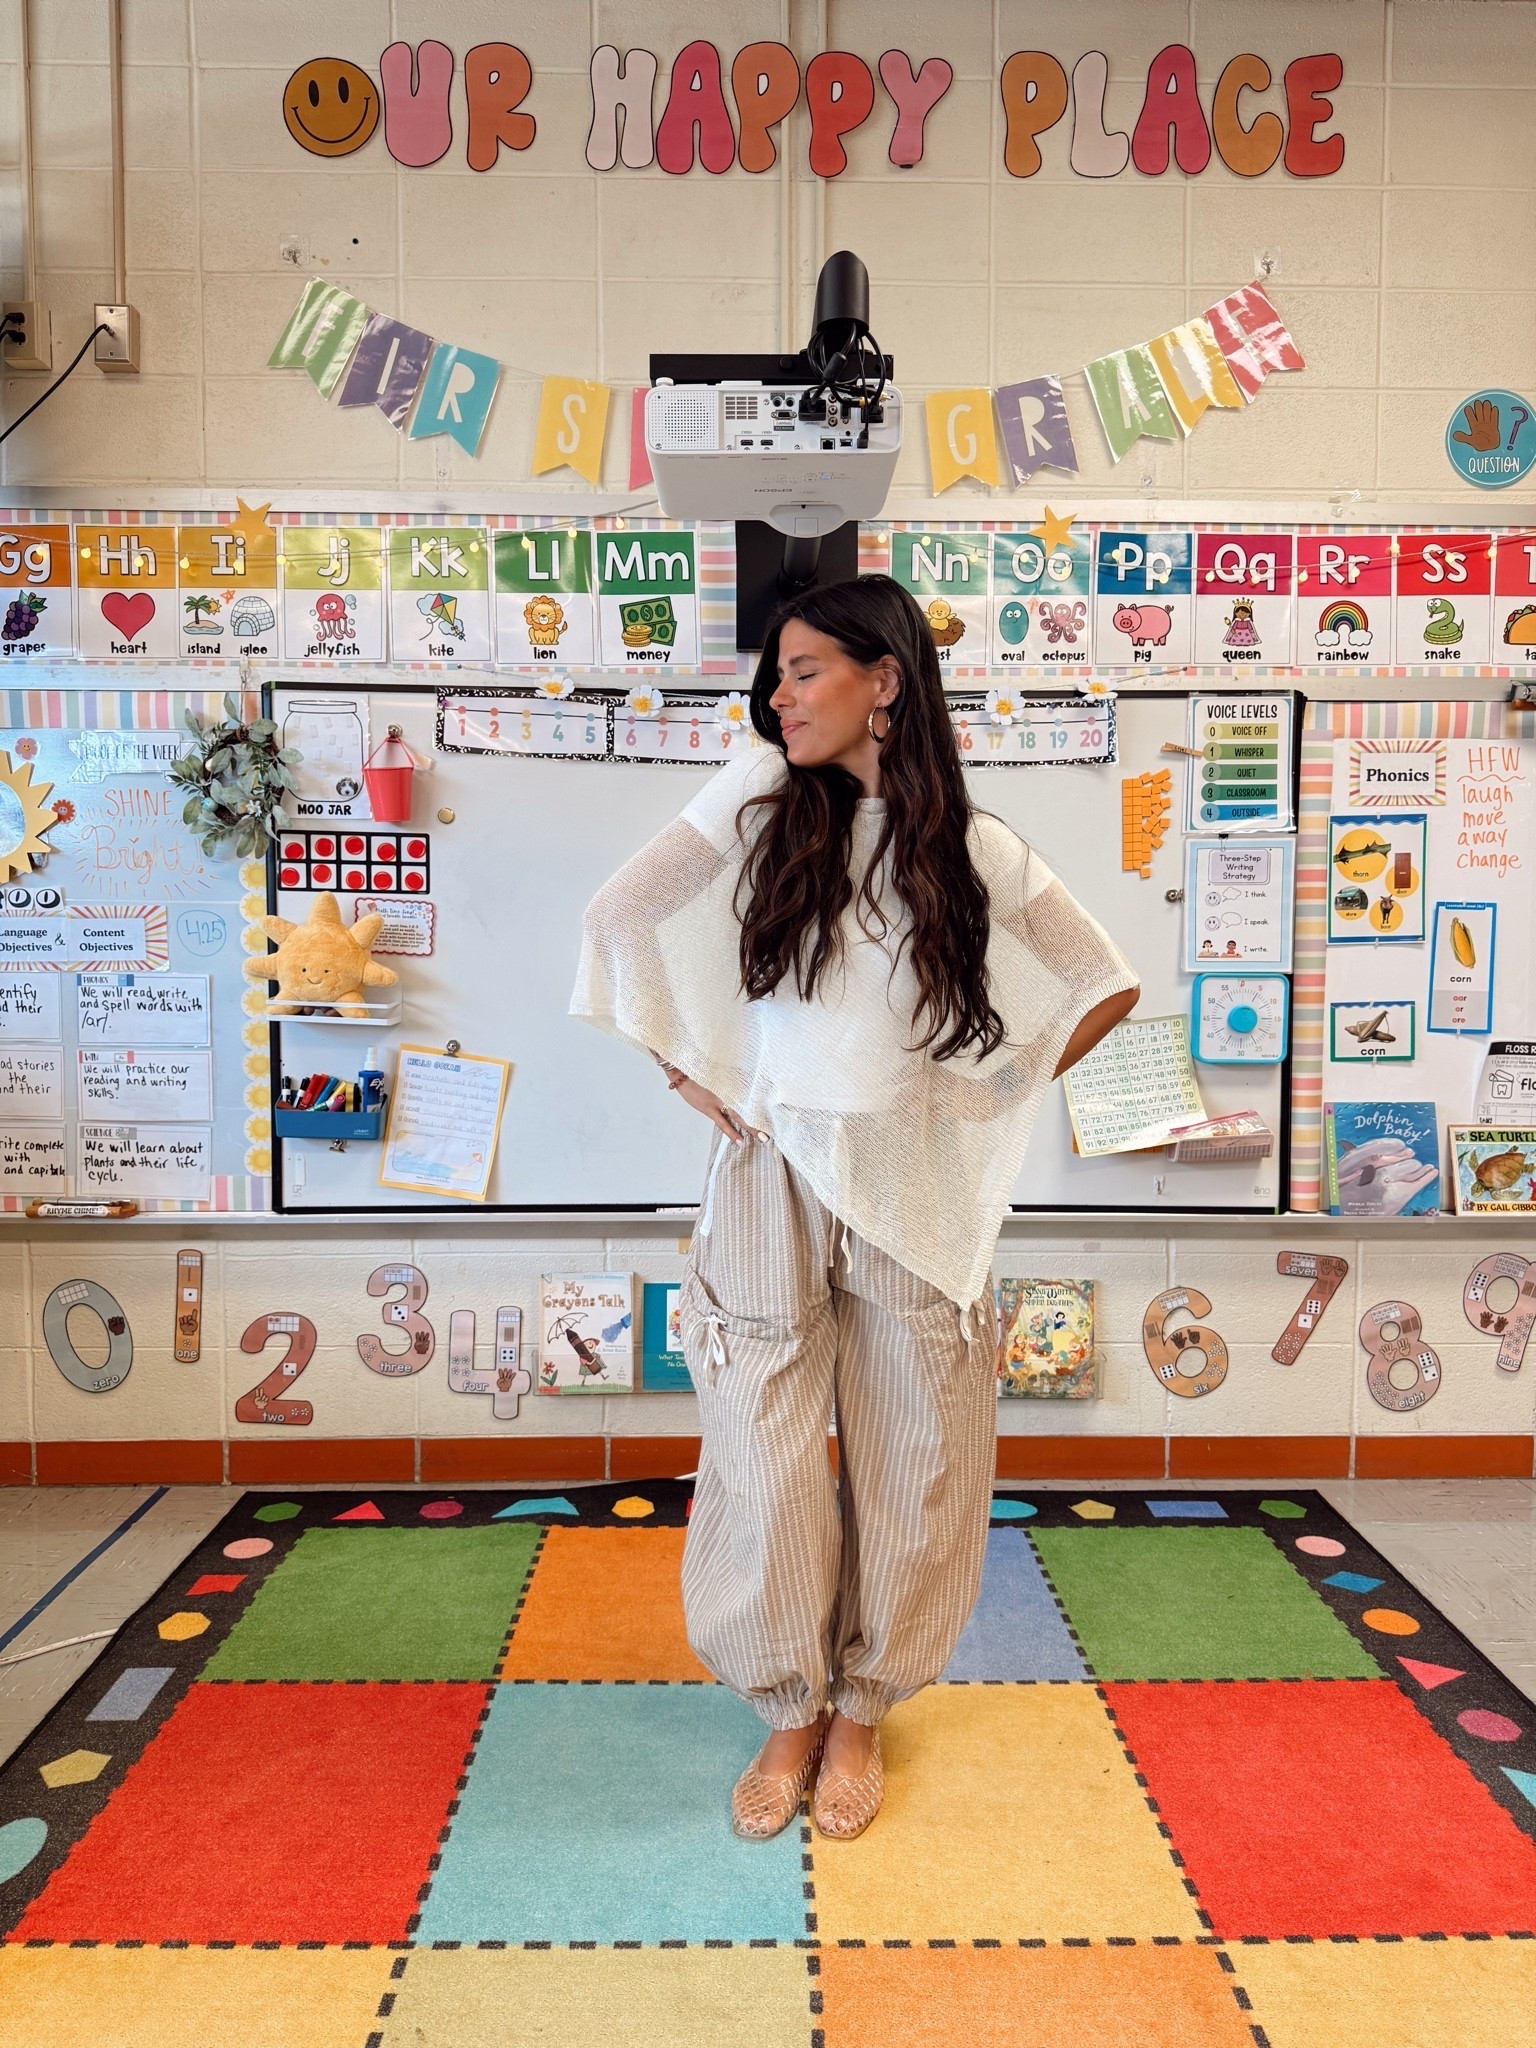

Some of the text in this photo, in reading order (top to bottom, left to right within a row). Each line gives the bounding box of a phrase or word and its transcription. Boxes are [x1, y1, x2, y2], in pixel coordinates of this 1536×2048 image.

[585, 40, 953, 177] HAPPY
[1000, 44, 1345, 178] PLACE
[1469, 457, 1519, 473] QUESTION
[0, 534, 51, 583] Gg
[99, 535, 157, 576] Hh
[211, 535, 248, 576] Ii
[317, 536, 350, 585] Jj
[410, 536, 469, 577] Kk
[604, 540, 690, 582] Mm
[910, 541, 970, 582] Nn
[1010, 543, 1074, 584] Oo
[1117, 541, 1173, 591] Pp
[1214, 543, 1276, 592] Qq
[1319, 544, 1371, 584] Rr
[1421, 543, 1467, 584] Ss
[2, 641, 46, 655] grapes
[111, 641, 147, 654] heart
[187, 643, 221, 655] island
[240, 644, 268, 656] igloo
[304, 643, 360, 657] jellyfish
[429, 644, 455, 657] kite
[533, 647, 557, 660] lion
[1425, 649, 1460, 660] snake
[626, 648, 671, 662] money
[936, 649, 951, 661] est
[1001, 650, 1025, 662] oval
[1042, 650, 1085, 663] octopus
[1134, 649, 1152, 662] pig
[1222, 649, 1261, 662] queen
[1317, 649, 1369, 661] rainbow
[1207, 705, 1277, 718] VOICE LEVELS
[458, 719, 595, 744] 1 2 3 4 5
[626, 728, 732, 749] 6 7 8 9
[1210, 726, 1267, 737] 0 VOICE OFF
[987, 733, 1004, 750] 17
[1018, 731, 1035, 749] 18
[1050, 731, 1068, 748] 19
[1080, 729, 1102, 747] 20
[153, 744, 180, 760] WEEK
[1210, 747, 1264, 757] 1 WHISPER
[1468, 747, 1521, 774] HFW
[1209, 767, 1256, 777] 2 QUIET
[1366, 769, 1429, 782] Phonics
[1208, 788, 1266, 798] 3 CLASSROOM
[1462, 784, 1512, 810] laugh
[104, 789, 174, 817] SHINE
[298, 804, 352, 815] MOO JAR
[1206, 808, 1260, 818] 4 OUTSIDE
[1463, 811, 1506, 828] move
[1458, 829, 1507, 847] away
[1220, 854, 1261, 862] Three-Step
[1457, 850, 1521, 878] change
[1223, 872, 1256, 880] Strategy
[55, 933, 65, 946] &
[83, 928, 125, 937] Content
[79, 942, 134, 952] Objectives
[81, 986, 98, 998] We
[102, 987, 122, 998] will
[15, 1000, 42, 1013] their
[80, 999, 99, 1008] and
[137, 998, 172, 1011] words
[176, 997, 202, 1012] with
[1361, 1047, 1386, 1055] corn
[1505, 1045, 1529, 1053] FLOSS
[18, 1058, 54, 1071] stories
[84, 1065, 98, 1074] We
[102, 1064, 120, 1073] will
[126, 1062, 166, 1076] practice
[9, 1072, 27, 1084] the
[84, 1075, 187, 1090] reading and writing
[20, 1083, 51, 1094] their
[88, 1088, 119, 1099] skills.
[1354, 1109, 1414, 1129] Dolphin
[85, 1129, 112, 1137] SCIENCE
[1384, 1123, 1431, 1144] Baby!
[1470, 1131, 1495, 1142] SEA
[86, 1140, 203, 1154] We will learn about
[4, 1152, 31, 1162] with
[84, 1155, 197, 1171] plants and their life
[4, 1164, 23, 1174] and
[1285, 1265, 1318, 1277] seven
[563, 1281, 584, 1297] My
[543, 1294, 625, 1310] Crayons Talk
[1272, 1251, 1348, 1365] 7
[357, 1262, 435, 1376] 3
[1143, 1286, 1228, 1397] 6
[176, 1349, 197, 1359] one
[1359, 1300, 1441, 1412] 8
[1498, 1355, 1520, 1367] nine
[235, 1311, 317, 1425] 2
[379, 1361, 412, 1373] three
[448, 1306, 531, 1419] 4
[93, 1374, 120, 1390] zero
[463, 1380, 489, 1391] four
[1193, 1383, 1210, 1394] six
[1399, 1391, 1425, 1409] eight
[262, 1411, 285, 1422] two
